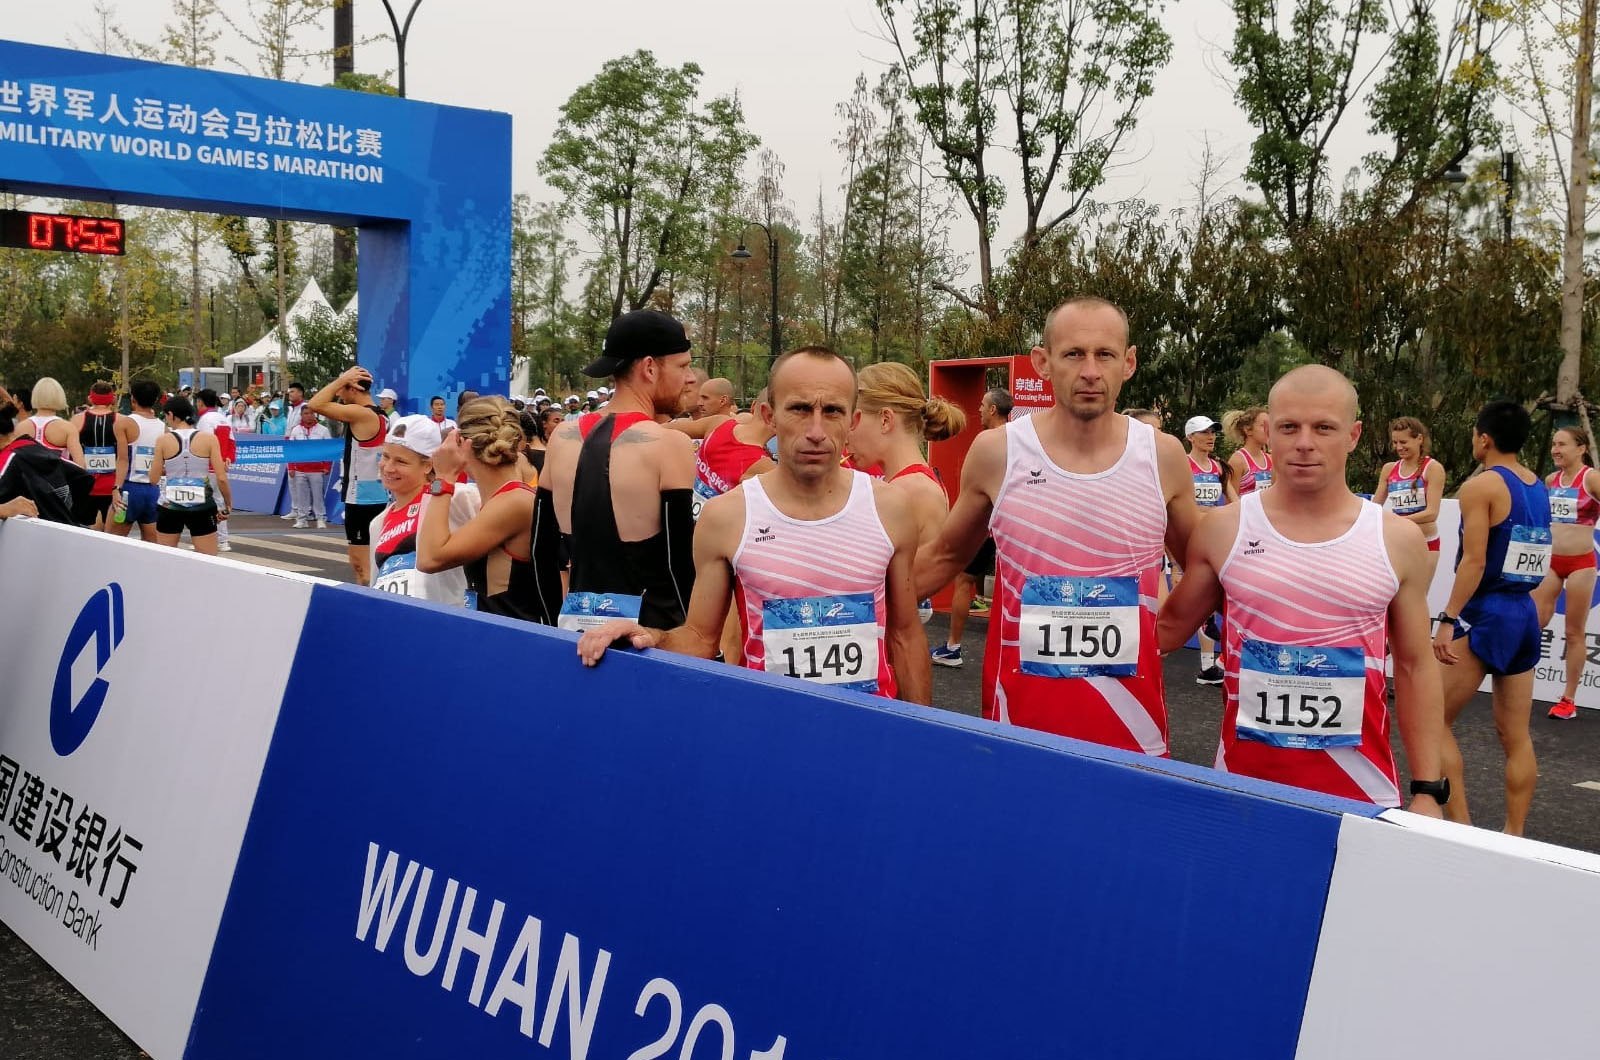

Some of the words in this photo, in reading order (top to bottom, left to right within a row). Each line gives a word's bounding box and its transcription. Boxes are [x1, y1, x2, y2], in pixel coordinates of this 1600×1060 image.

[0, 80, 383, 158] 世界军人运动会马拉松比赛
[0, 122, 105, 152] MILITARY
[111, 134, 192, 162] WORLD
[197, 146, 269, 171] GAMES
[274, 155, 383, 184] MARATHON
[30, 214, 121, 252] 07:52
[1014, 393, 1038, 402] Crossing
[1038, 394, 1053, 402] Point
[1015, 378, 1044, 391] 穿越点
[89, 458, 110, 468] CAN
[696, 457, 730, 493] POLSKA
[175, 491, 195, 501] LTU
[1195, 488, 1219, 500] 2150
[1551, 503, 1570, 516] 145
[755, 534, 776, 543] erima
[1515, 552, 1546, 572] PRK
[1037, 624, 1122, 658] 1150
[782, 642, 863, 679] 1149
[1255, 691, 1342, 728] 1152
[0, 753, 143, 909] 国建设银行
[63, 890, 103, 951] Bank
[355, 841, 612, 1060] WUHAN
